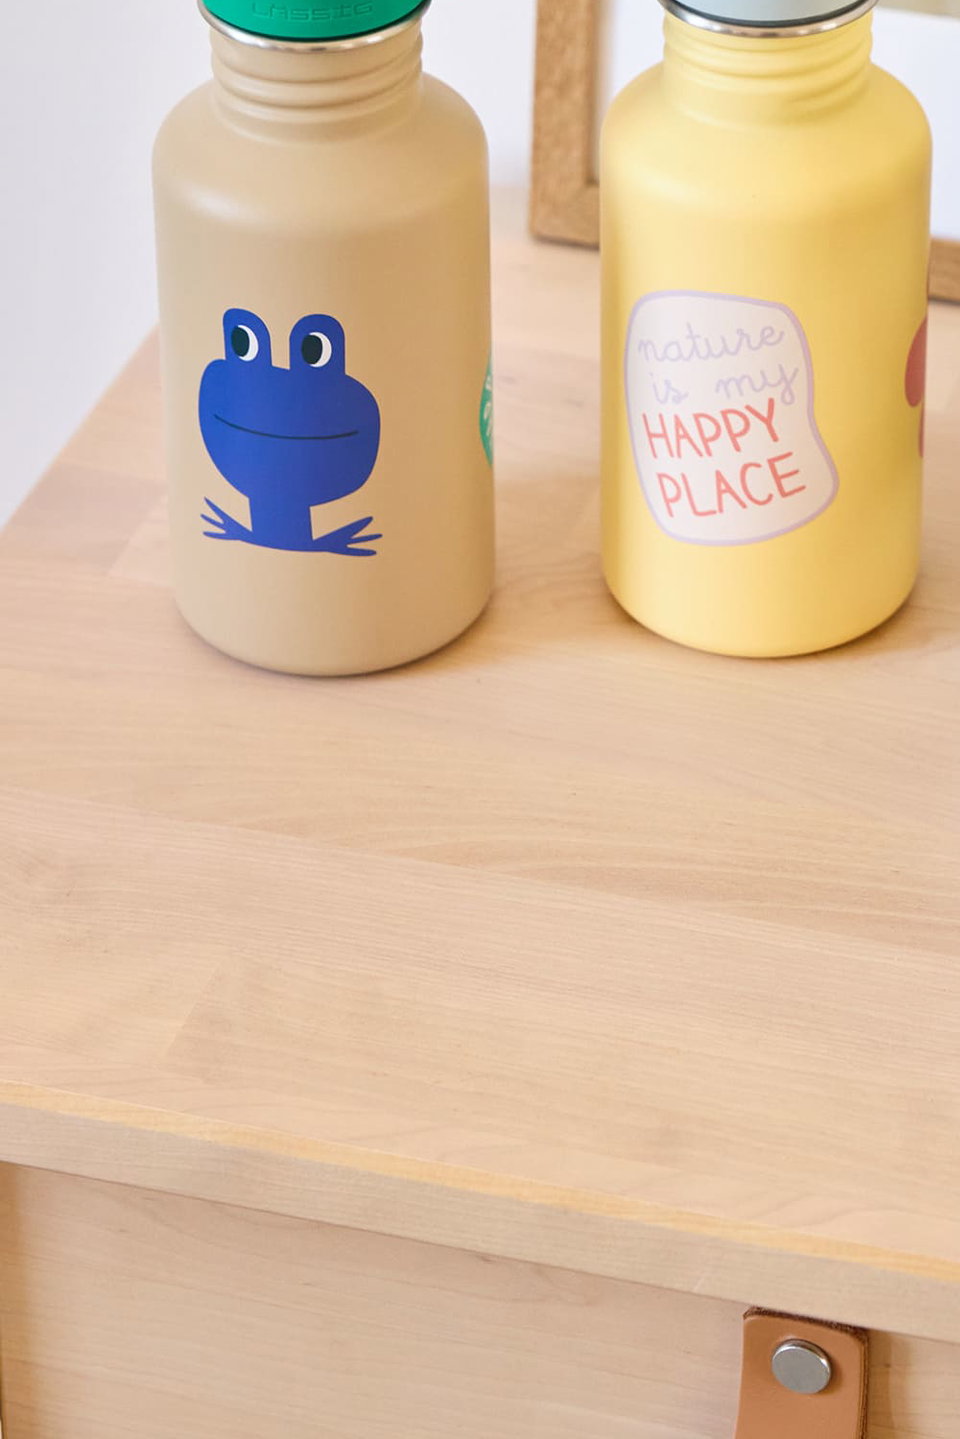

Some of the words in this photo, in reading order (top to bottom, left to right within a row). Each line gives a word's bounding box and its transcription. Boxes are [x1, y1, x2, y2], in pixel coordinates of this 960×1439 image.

[638, 322, 785, 362] nature
[649, 372, 689, 404] is
[715, 364, 799, 406] my
[642, 397, 779, 459] HAPPY
[656, 451, 806, 518] PLACE
